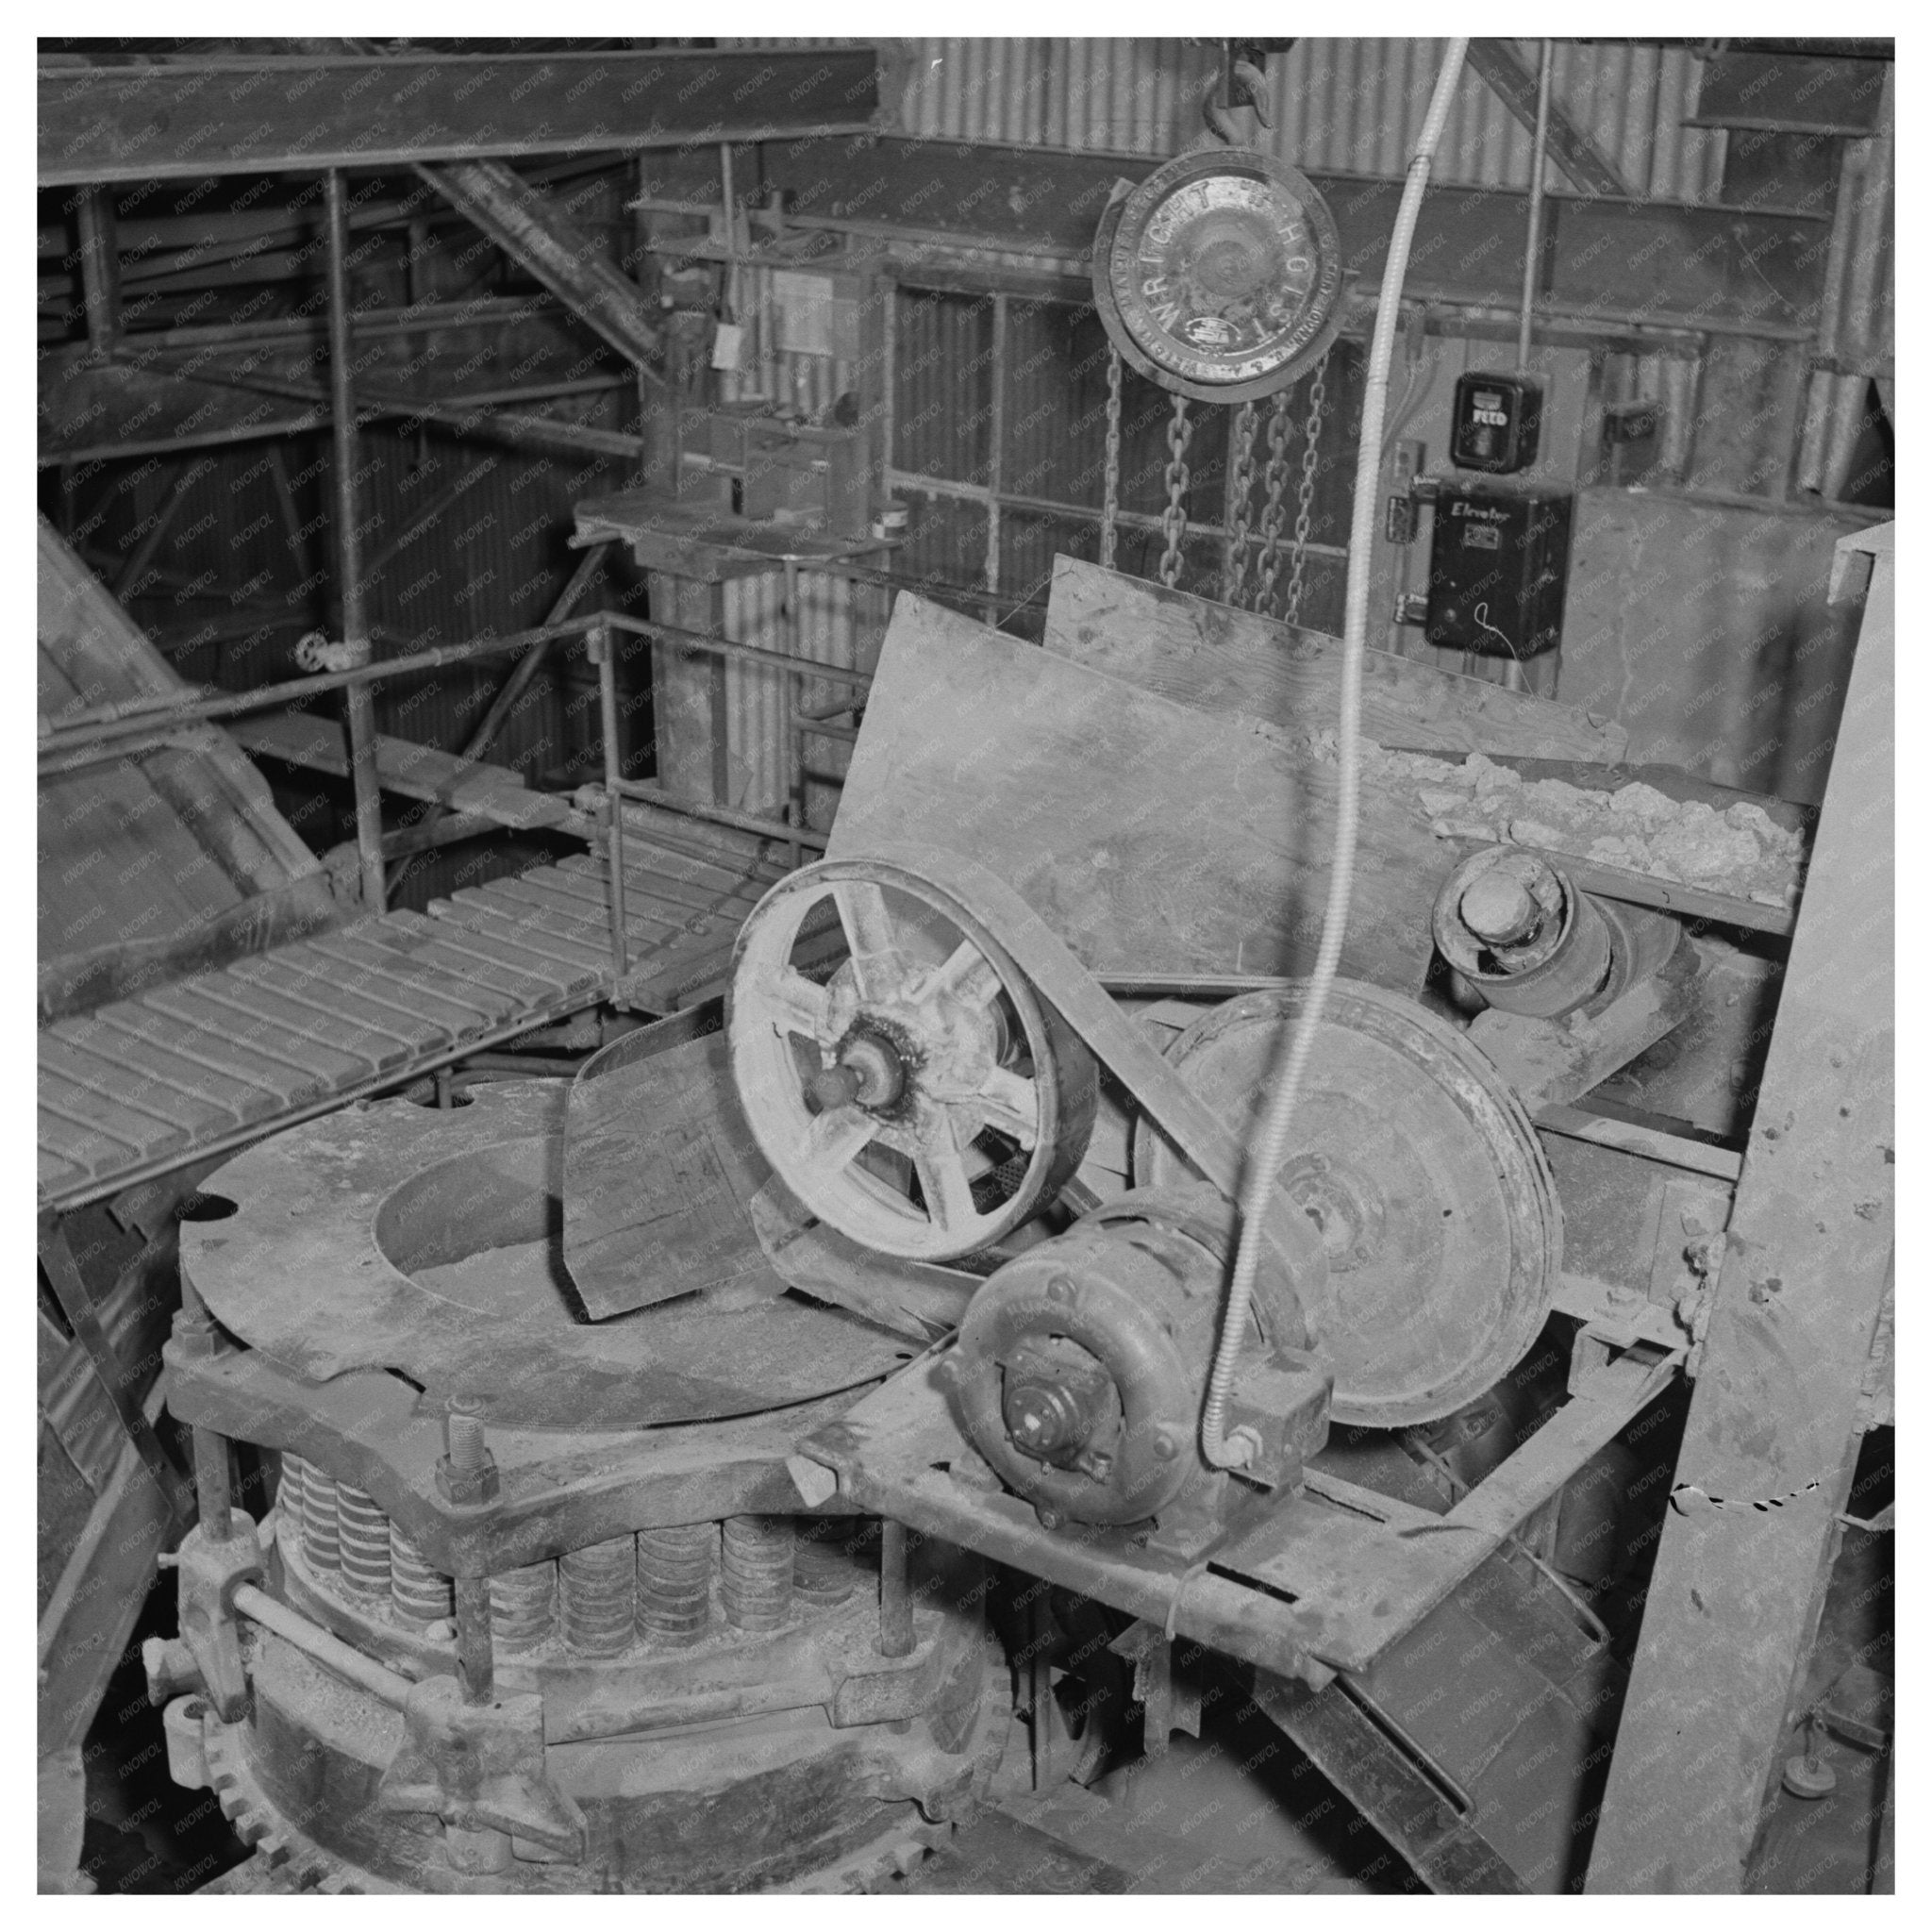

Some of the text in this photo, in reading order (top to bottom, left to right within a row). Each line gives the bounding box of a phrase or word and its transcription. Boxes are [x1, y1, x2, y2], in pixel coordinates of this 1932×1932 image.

[1140, 179, 1210, 333] WRIGHT
[1253, 223, 1309, 344] HOIST
[1473, 408, 1507, 425] FEED
